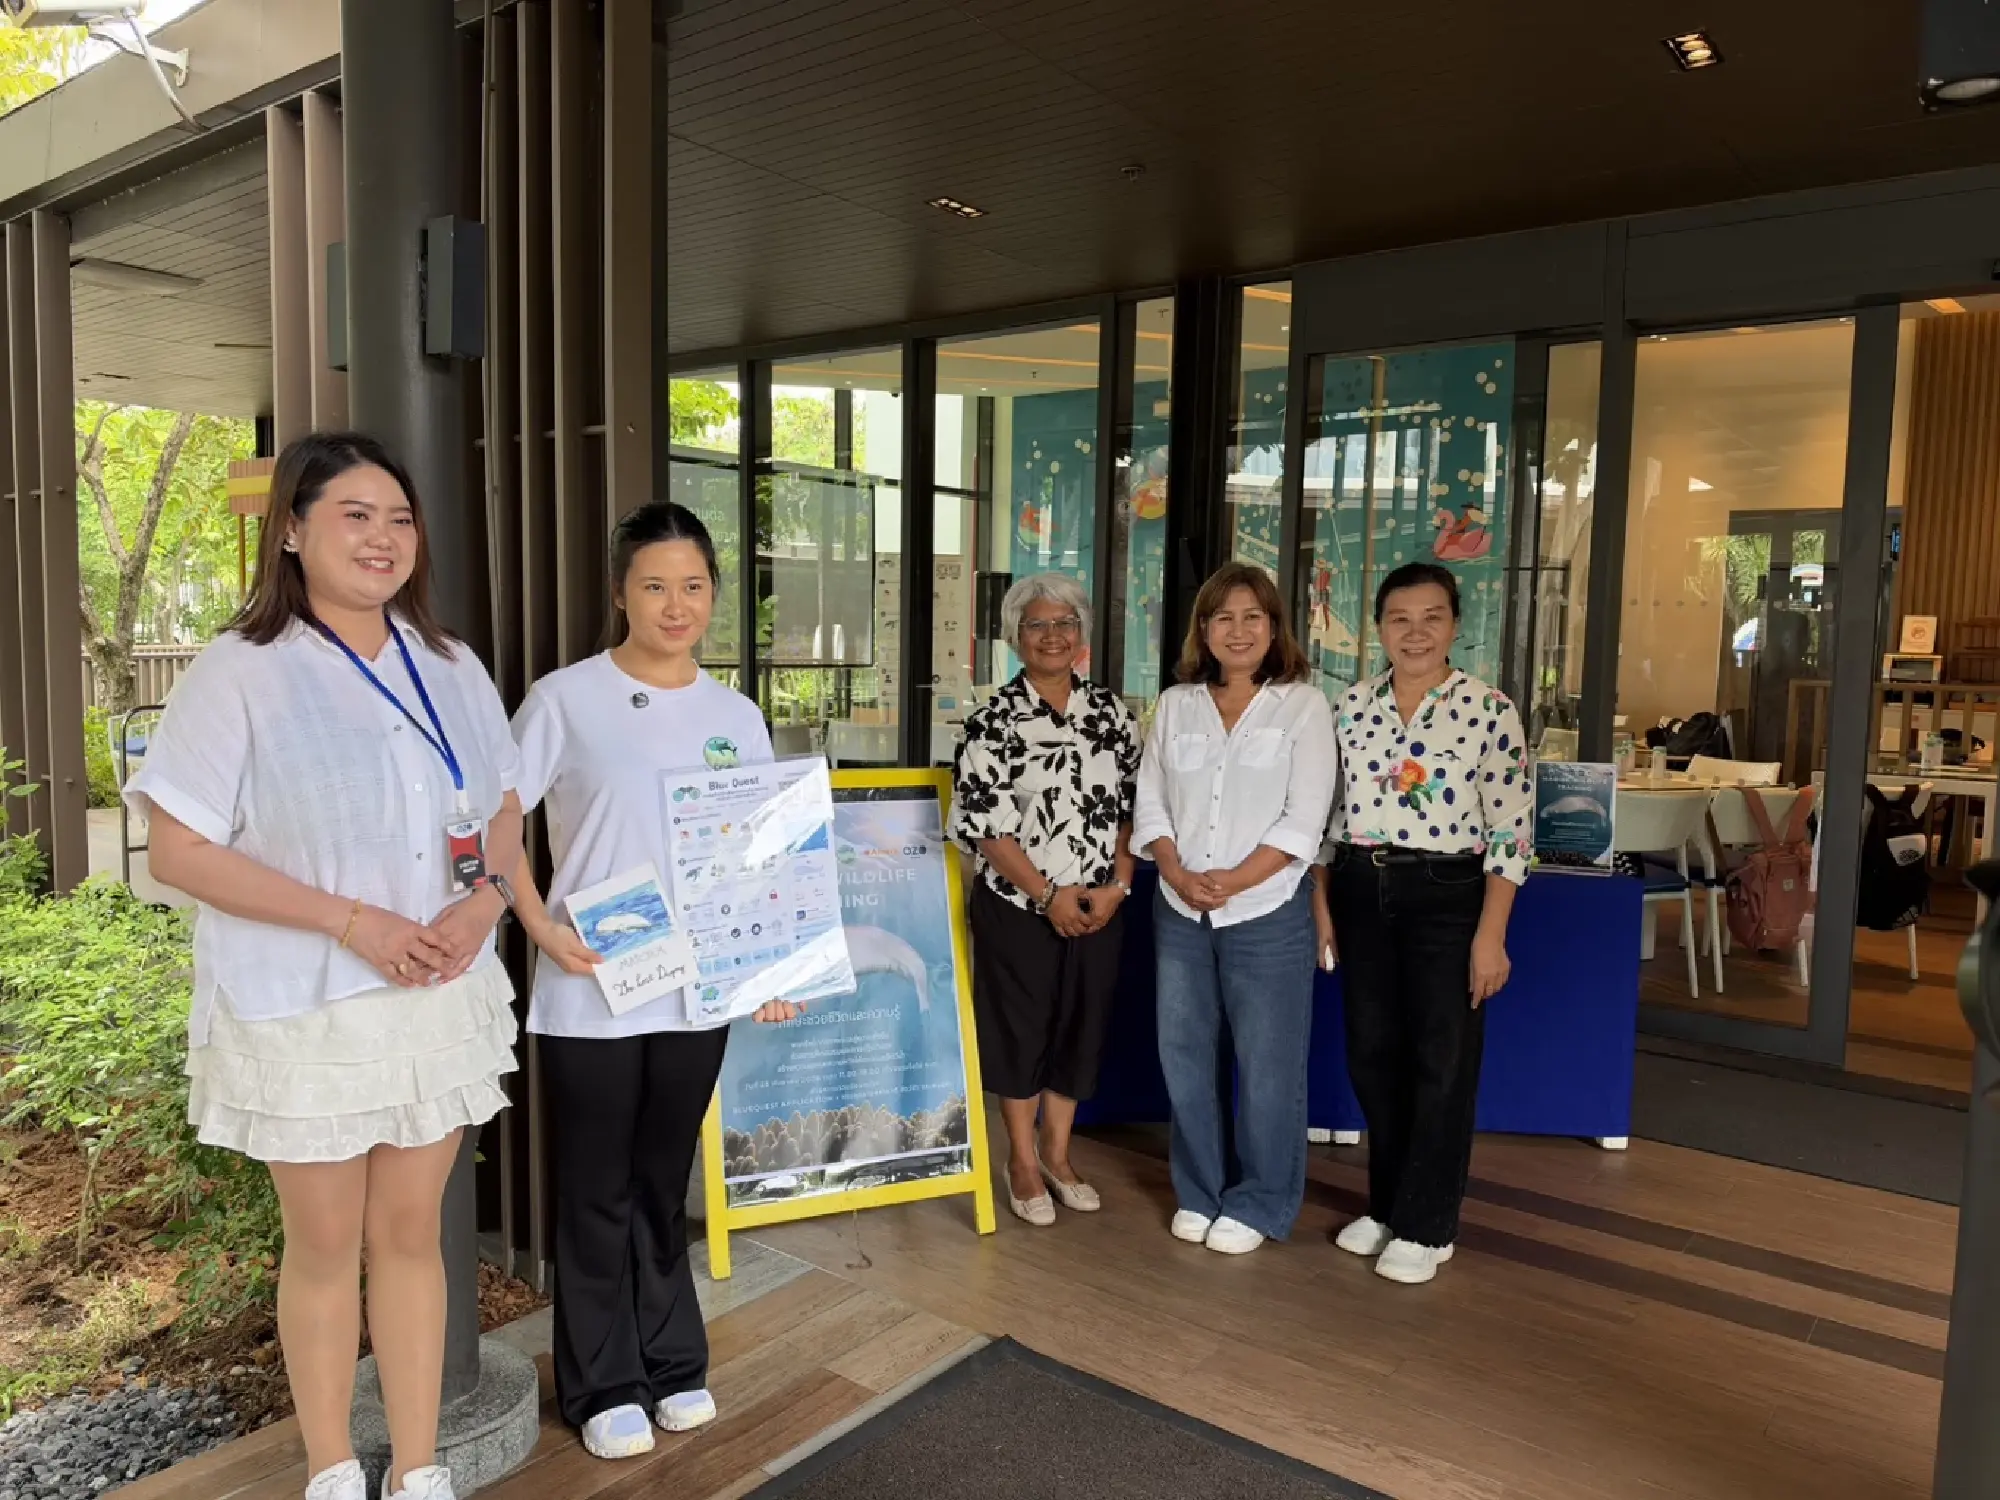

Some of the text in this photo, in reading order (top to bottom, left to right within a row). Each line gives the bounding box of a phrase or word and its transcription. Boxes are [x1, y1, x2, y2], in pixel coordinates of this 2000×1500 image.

[708, 776, 759, 791] Blue Quest
[839, 893, 879, 909] ING
